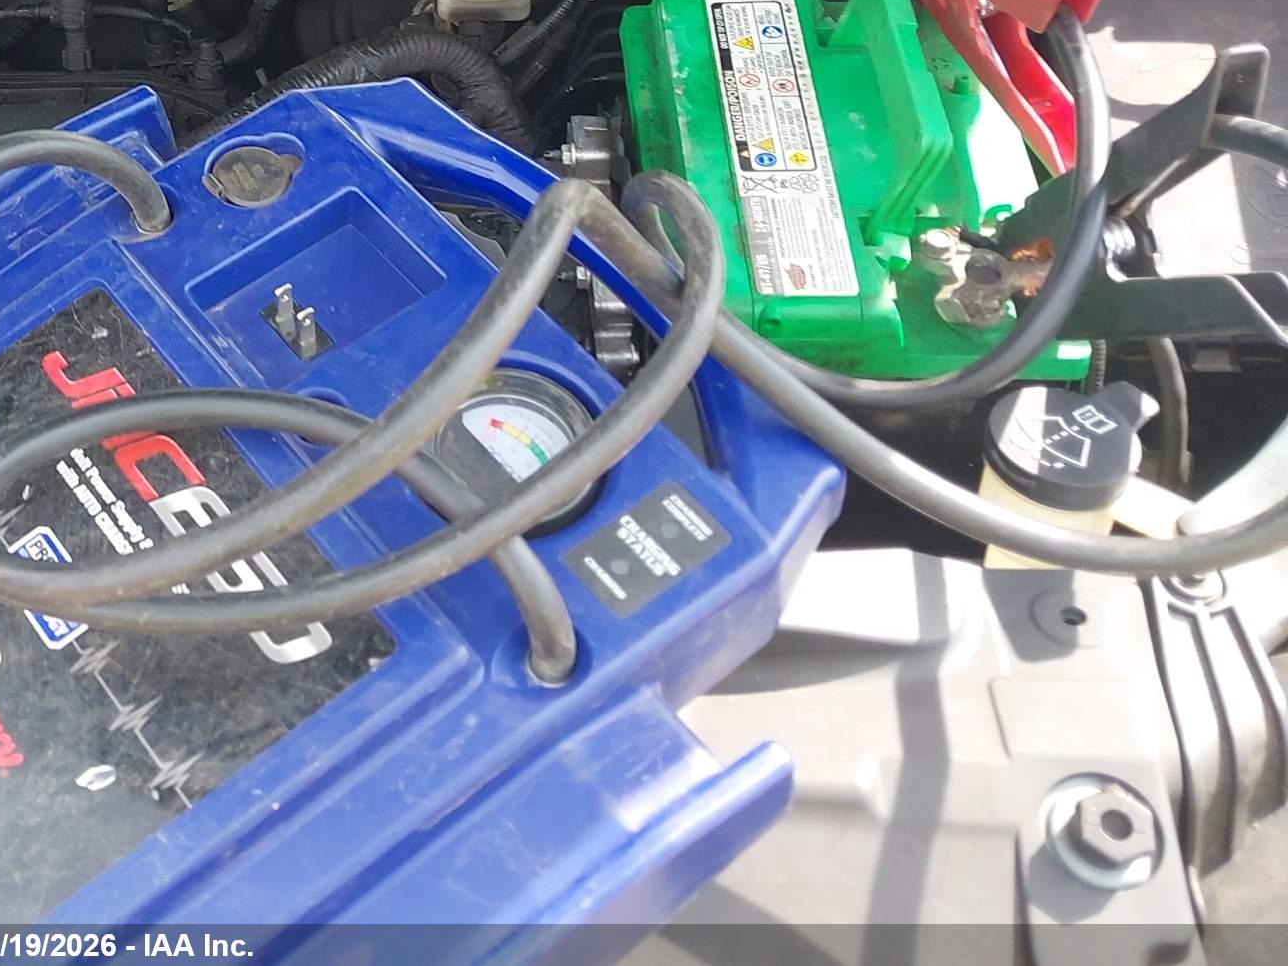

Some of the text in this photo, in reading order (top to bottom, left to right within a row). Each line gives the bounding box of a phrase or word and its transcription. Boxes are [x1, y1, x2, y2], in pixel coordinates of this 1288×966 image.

[723, 70, 747, 141] DANGER/POISON
[73, 484, 102, 516] AUTO
[617, 524, 668, 576] STATUS
[620, 515, 681, 576] CHARGING
